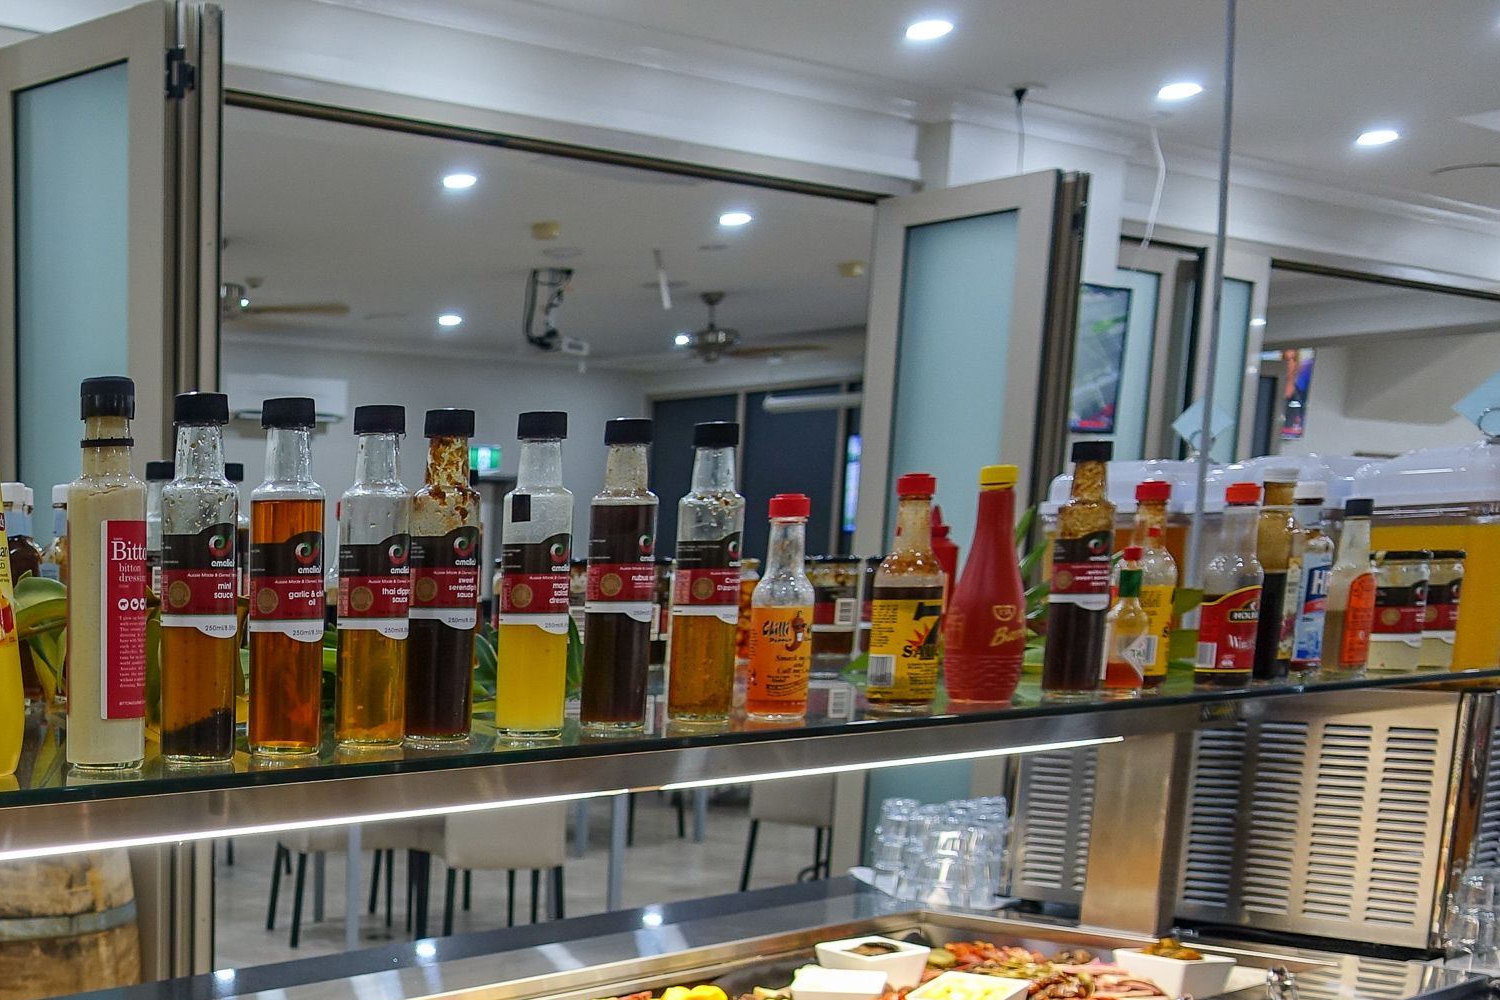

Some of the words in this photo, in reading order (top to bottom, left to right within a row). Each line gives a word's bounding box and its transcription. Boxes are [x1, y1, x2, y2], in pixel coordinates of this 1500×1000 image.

[118, 563, 141, 572] bitton
[218, 582, 232, 590] mint
[288, 590, 310, 600] garlic
[762, 620, 789, 637] Chilli
[913, 602, 941, 660] 7
